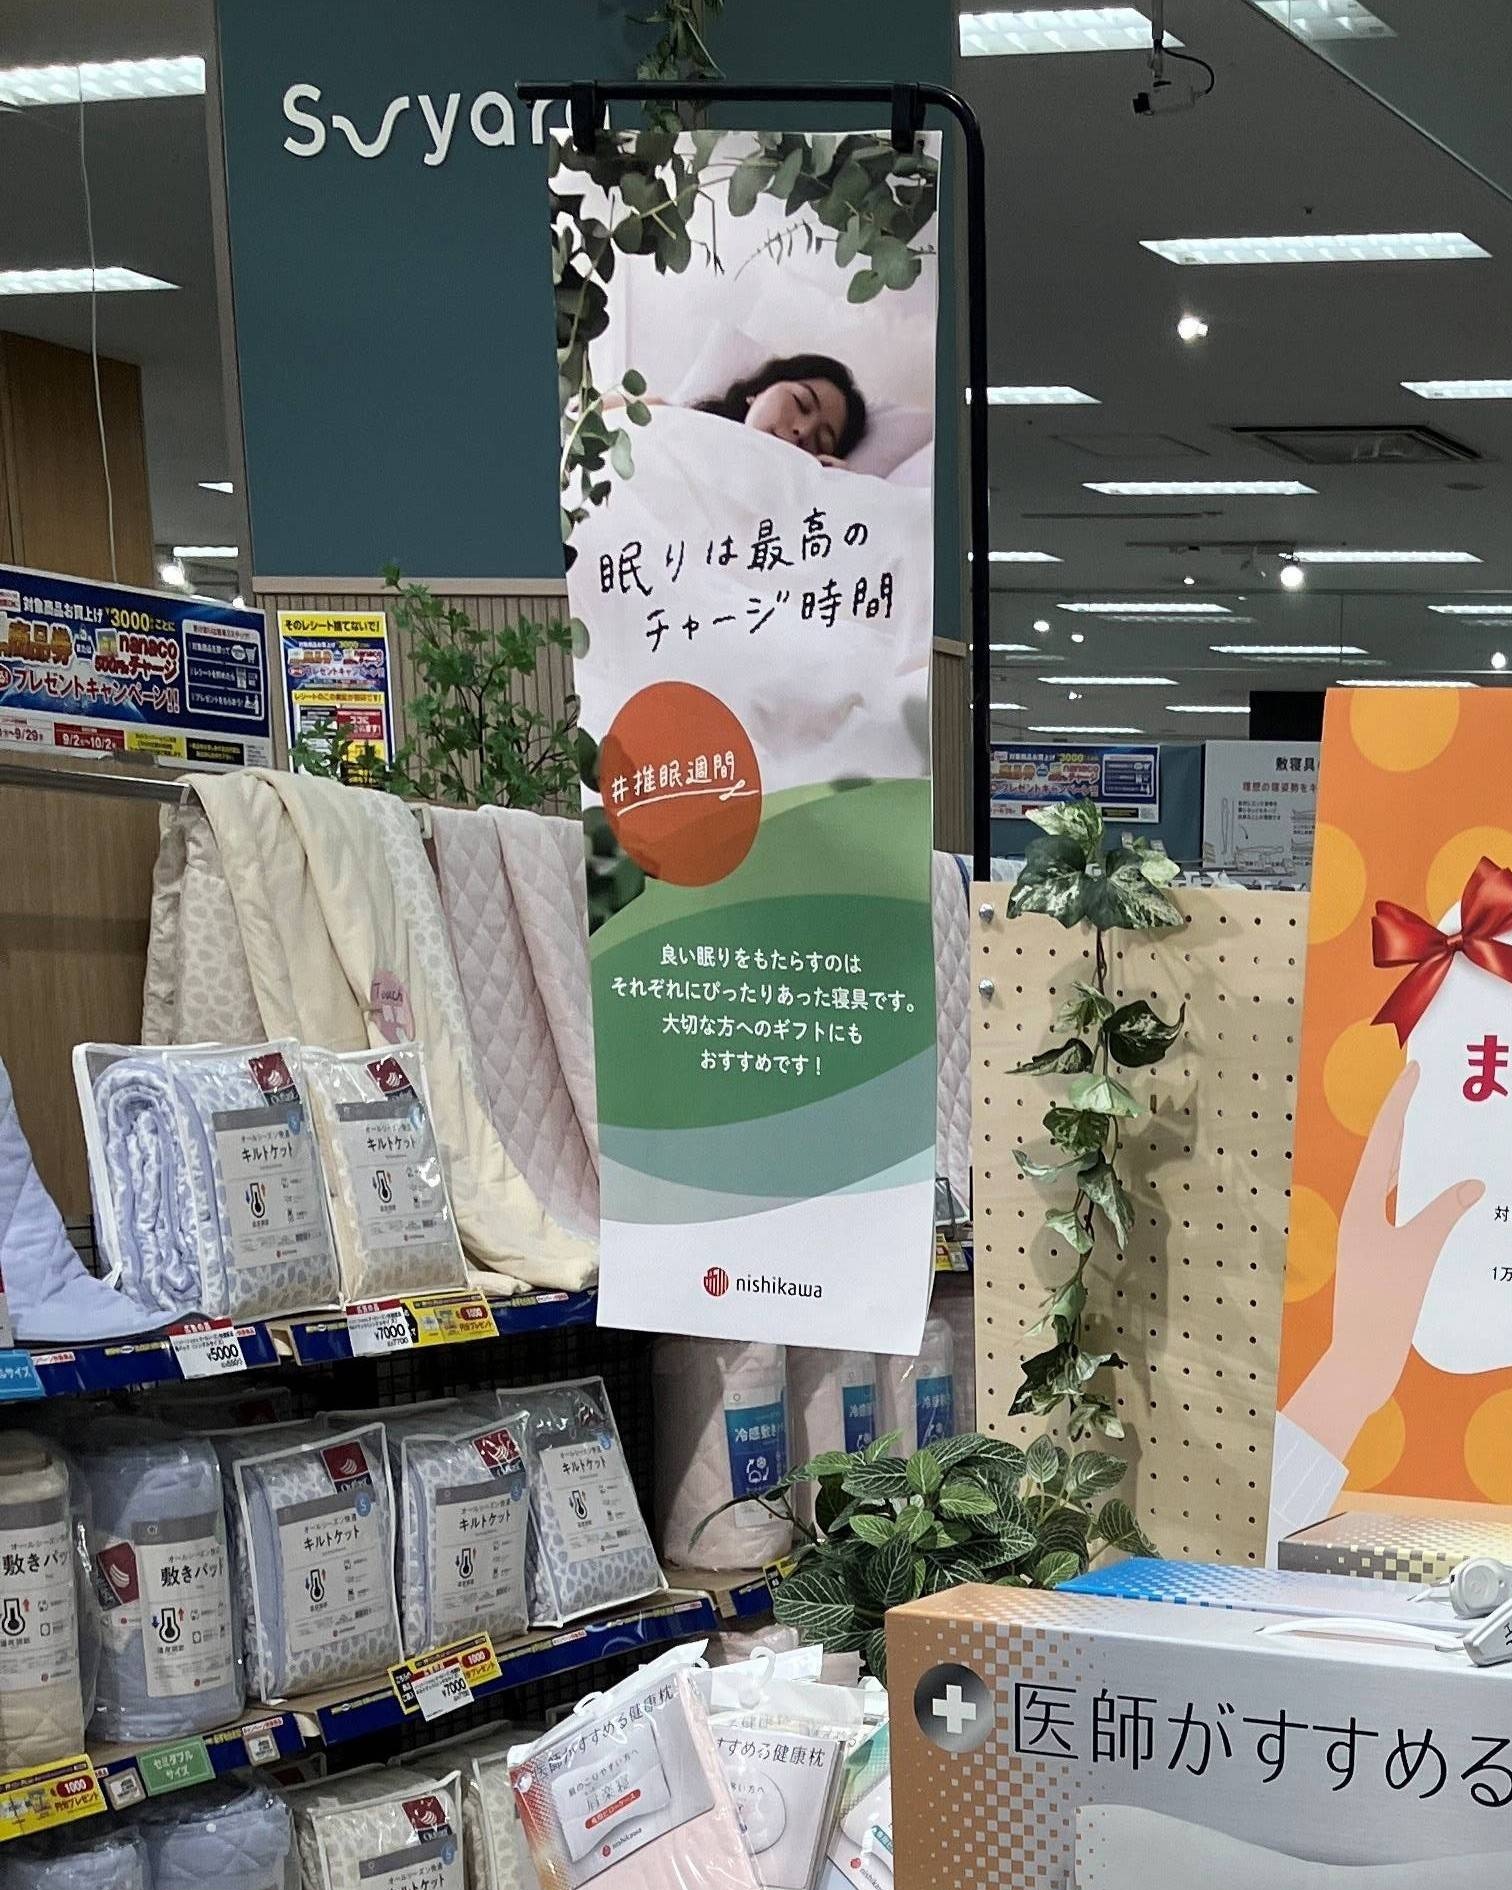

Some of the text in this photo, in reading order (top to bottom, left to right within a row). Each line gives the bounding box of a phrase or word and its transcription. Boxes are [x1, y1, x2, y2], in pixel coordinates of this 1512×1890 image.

[599, 508, 869, 597] 眠りは最高の
[646, 572, 893, 652] チャージ時間
[660, 944, 862, 974] 良い眠りをもたらすのは
[611, 977, 915, 1012] それぞれにぴったりあった寝具です。
[662, 1014, 862, 1044] 大切な方へのギフトにも
[700, 1049, 822, 1076] おすすめです!
[242, 1142, 293, 1162] キルトケット
[736, 1277, 822, 1299] nishikawa
[562, 1456, 607, 1477] キルトケット
[458, 1511, 511, 1532] キルトケット
[304, 1527, 360, 1551] キルトケット
[64, 1779, 87, 1793] 1000
